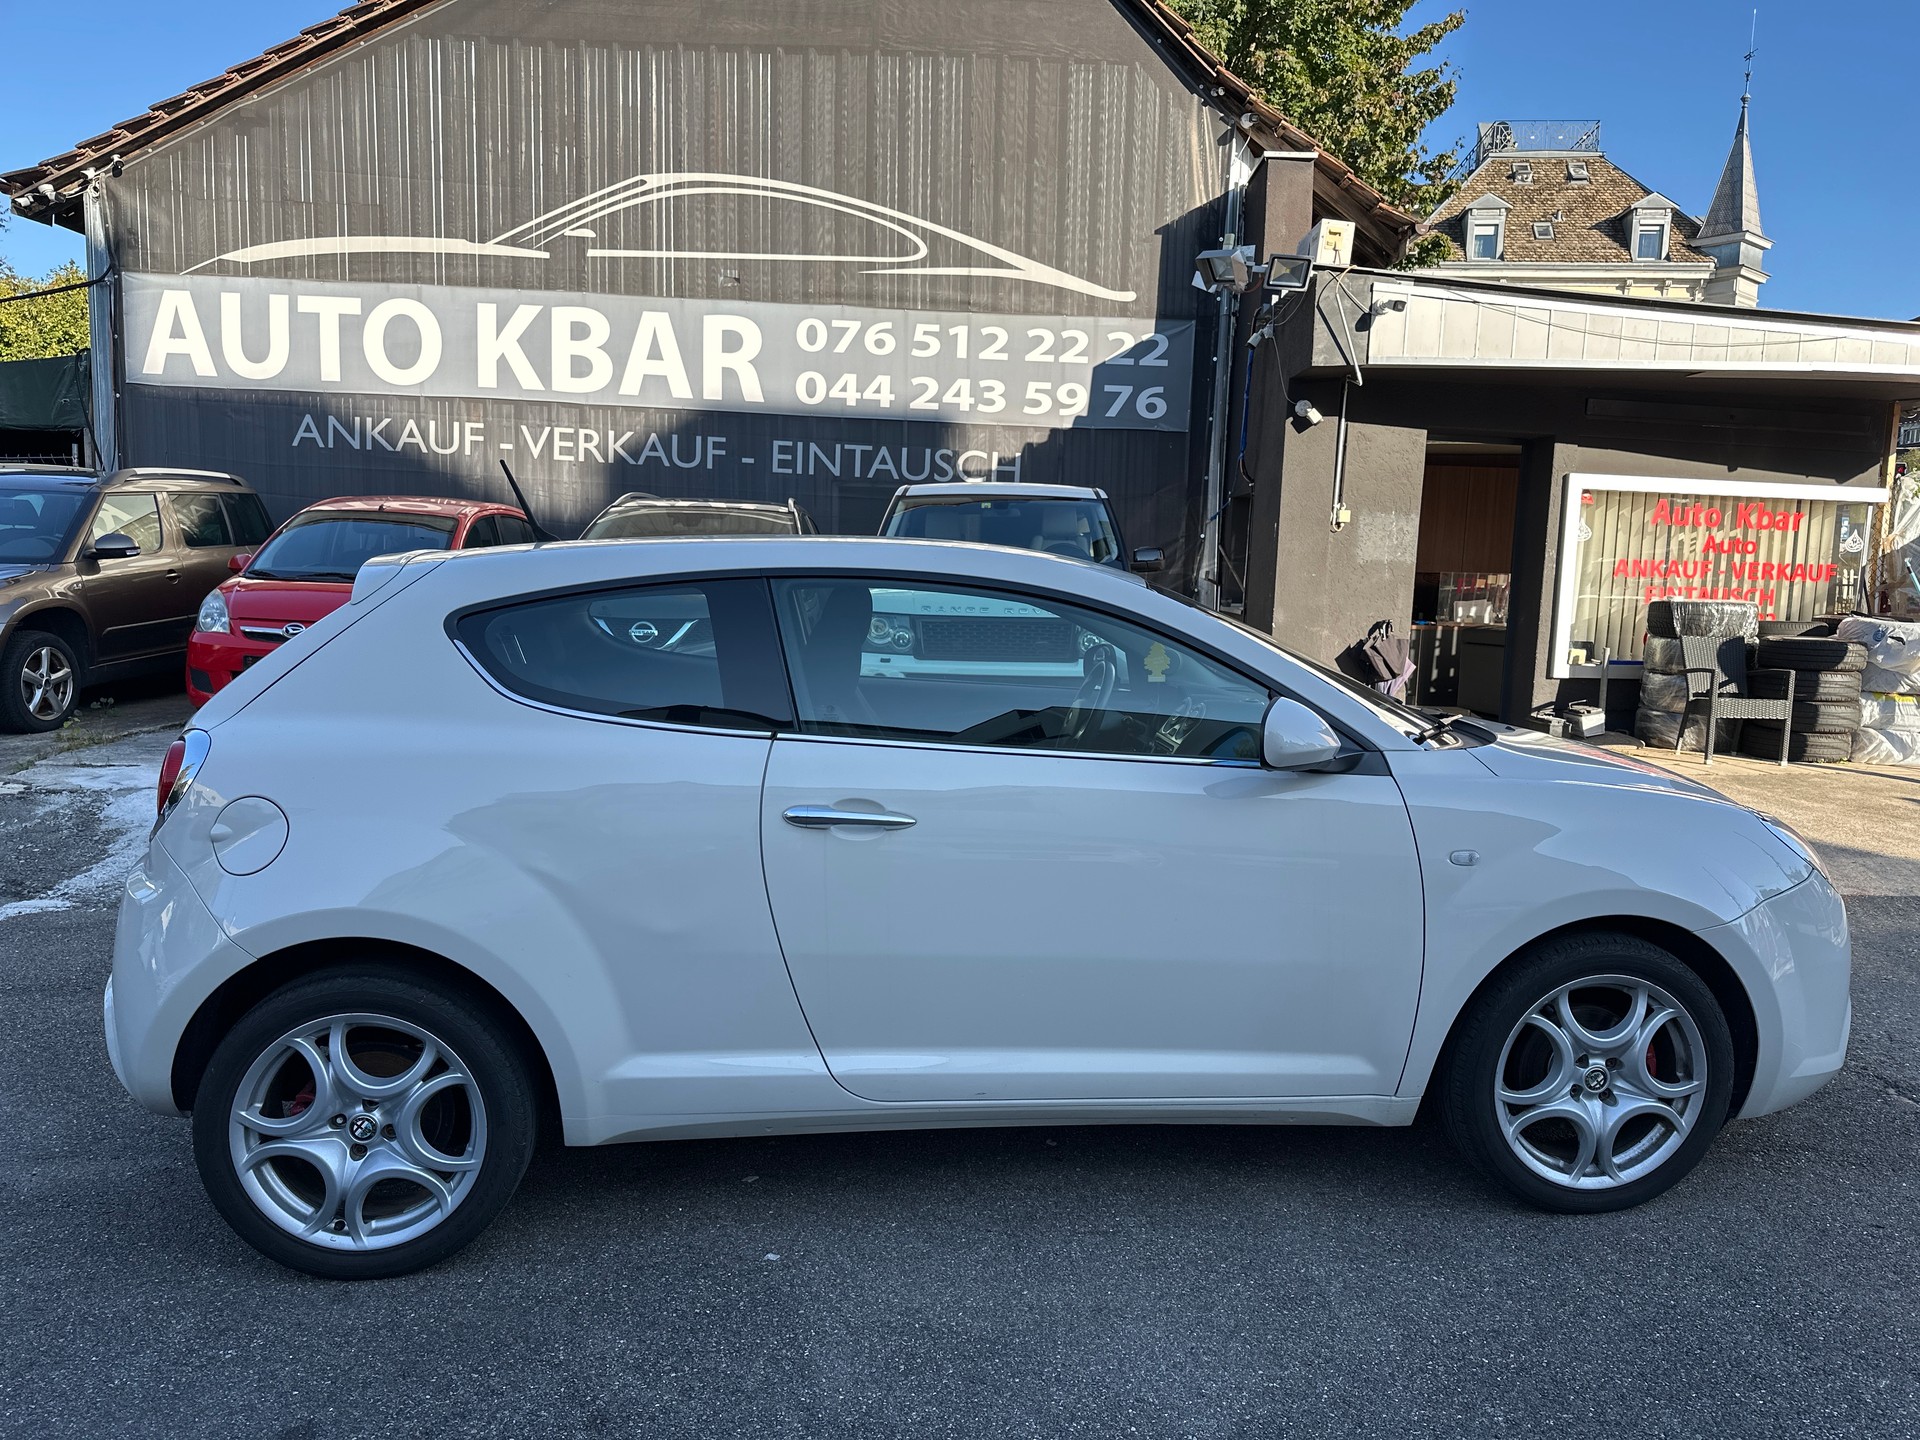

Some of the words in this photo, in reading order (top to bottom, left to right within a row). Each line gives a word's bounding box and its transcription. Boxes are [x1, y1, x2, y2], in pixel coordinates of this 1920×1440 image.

[142, 290, 443, 387] AUTO
[477, 302, 765, 403] KBAR
[795, 317, 897, 356] 076
[911, 324, 1010, 362] 512
[1024, 327, 1090, 365] 22
[1104, 331, 1170, 367] 22
[795, 370, 896, 408] 044
[909, 375, 1007, 416] 243
[1022, 381, 1089, 416] 59
[1103, 385, 1168, 420] 76
[291, 413, 485, 457] ANKAUF
[520, 424, 728, 470] VERKAUF
[771, 439, 1022, 484] EINTAUSCH
[1650, 498, 1722, 528] Auto
[1736, 502, 1805, 532] Kbar
[1701, 533, 1758, 555] Auto
[1613, 558, 1713, 580] ANKAUF
[1731, 561, 1838, 583] VERKAUF
[921, 605, 990, 614] RANGE
